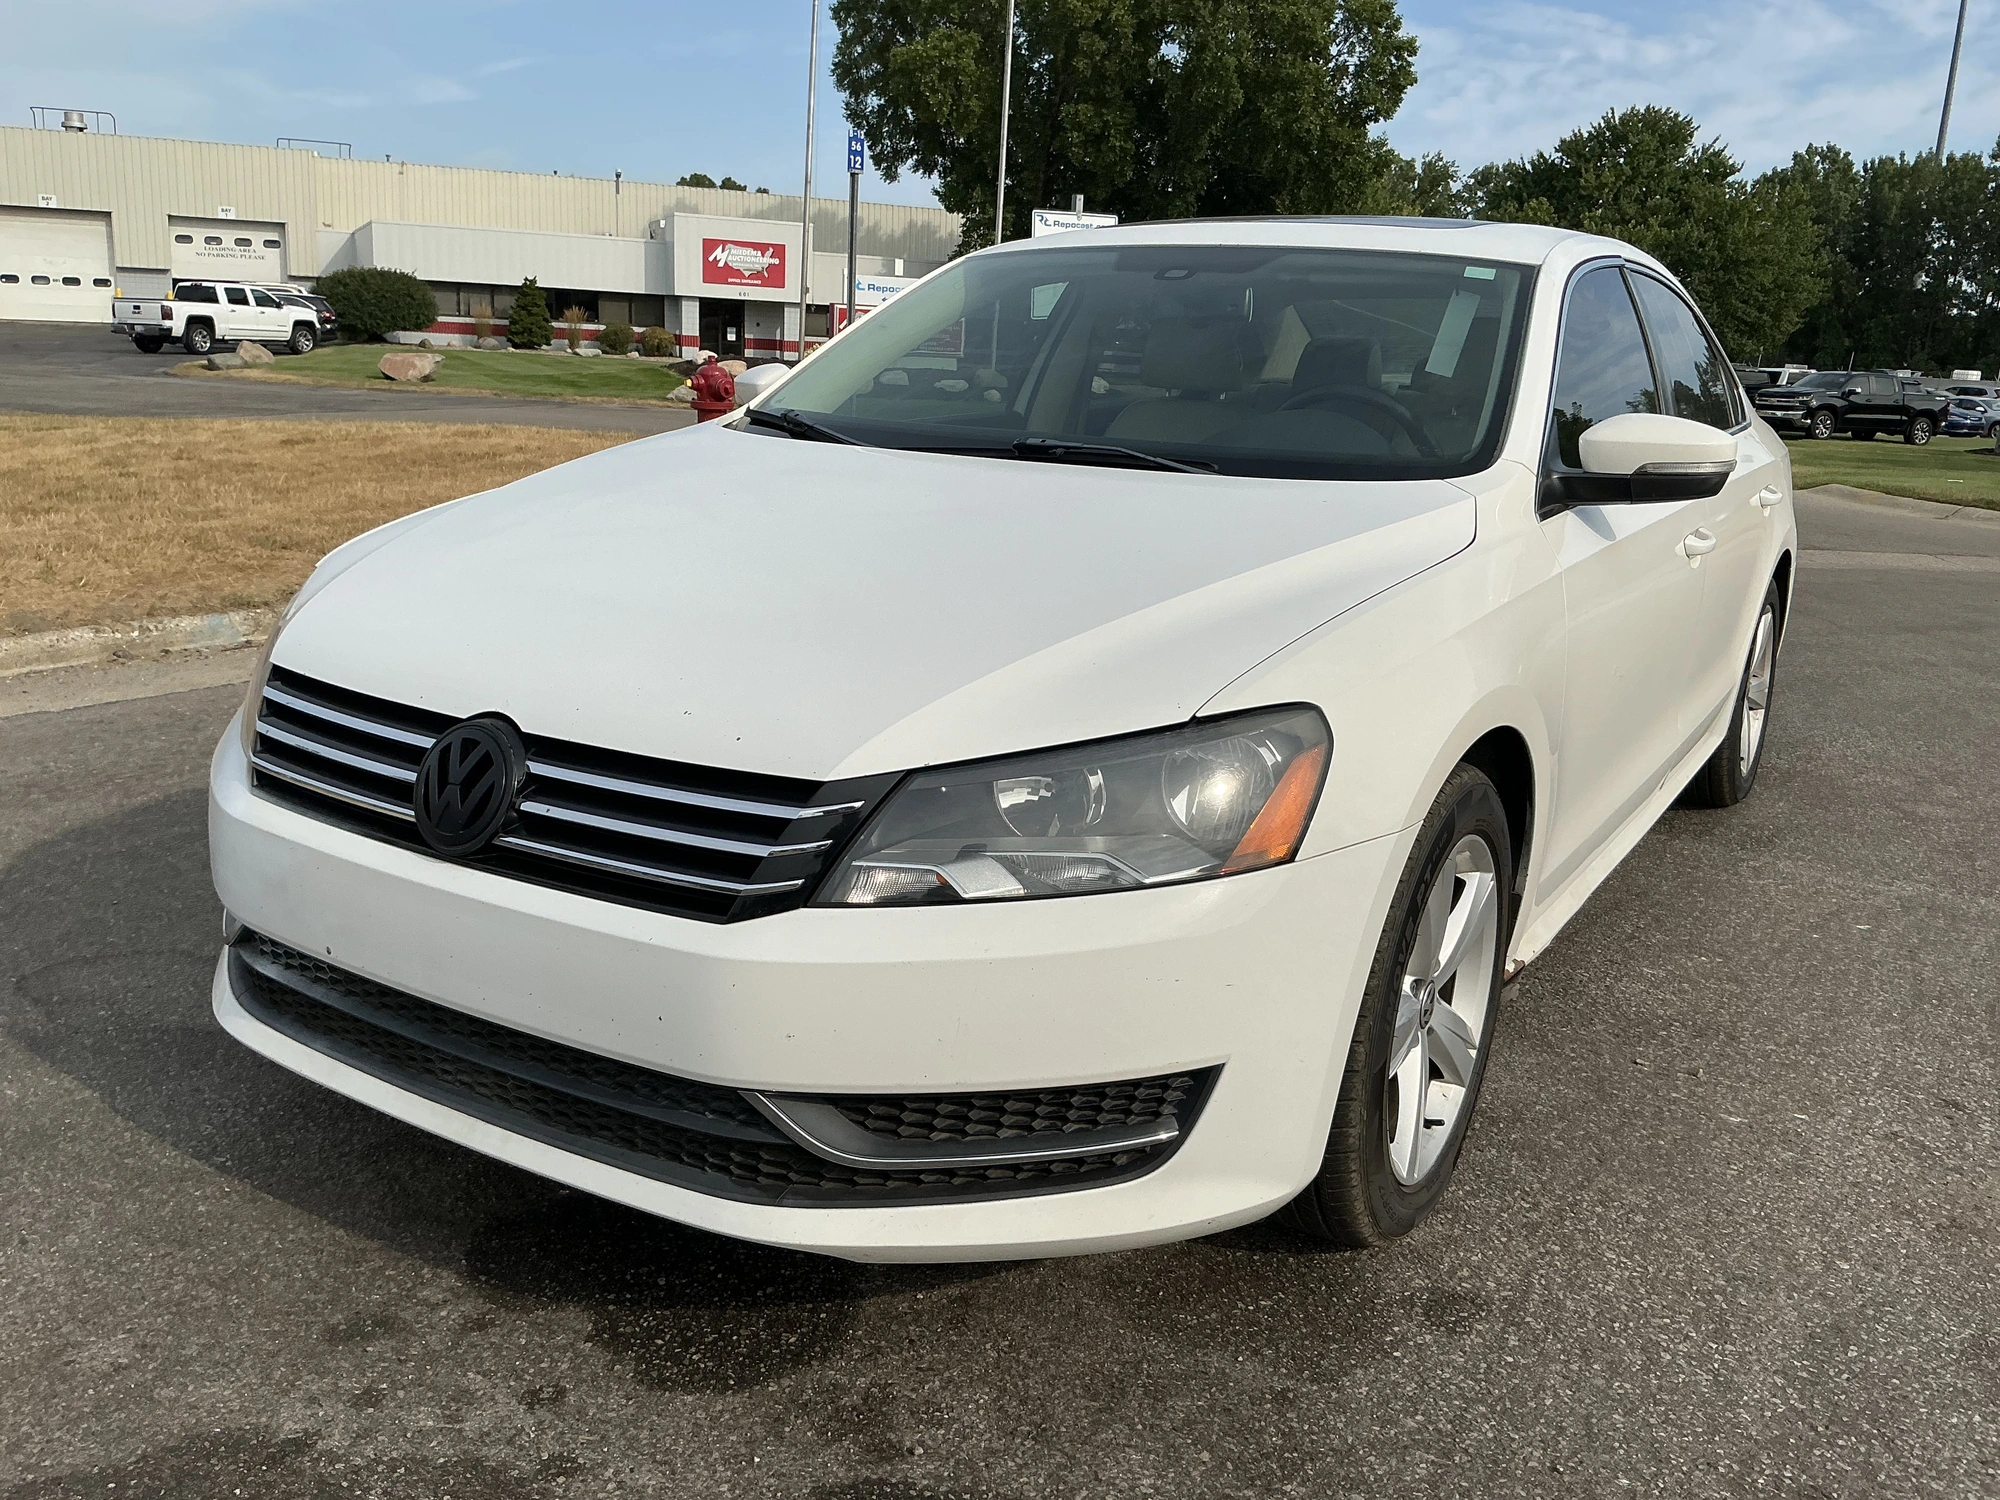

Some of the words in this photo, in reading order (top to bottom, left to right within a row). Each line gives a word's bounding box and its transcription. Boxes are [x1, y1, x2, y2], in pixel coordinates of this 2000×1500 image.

[851, 141, 862, 151] 56
[850, 155, 862, 168] 12
[730, 248, 762, 257] MIEDEMA
[726, 254, 780, 265] AUCTIONEERING
